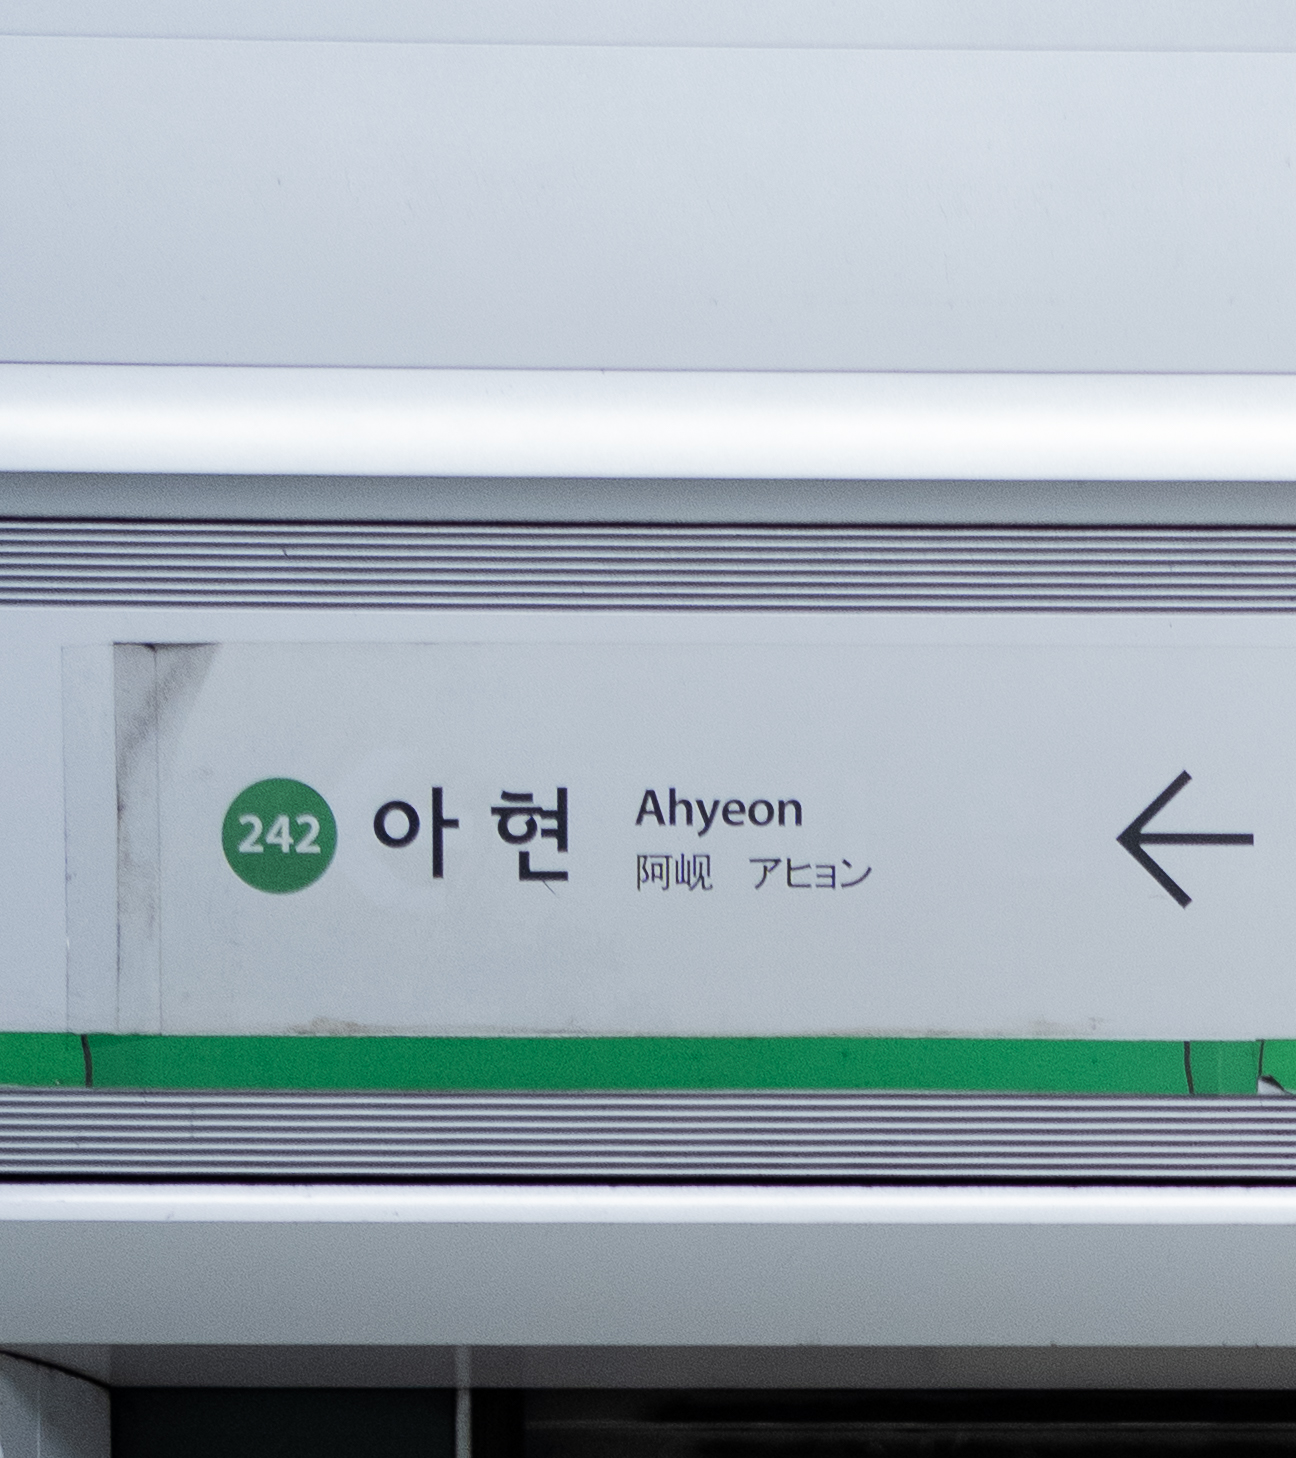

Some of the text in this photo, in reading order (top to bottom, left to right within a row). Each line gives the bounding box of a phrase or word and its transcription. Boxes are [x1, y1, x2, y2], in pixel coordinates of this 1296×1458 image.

[635, 787, 803, 837] Ahyeon
[237, 814, 321, 855] 242
[749, 858, 873, 890] アヒョン
